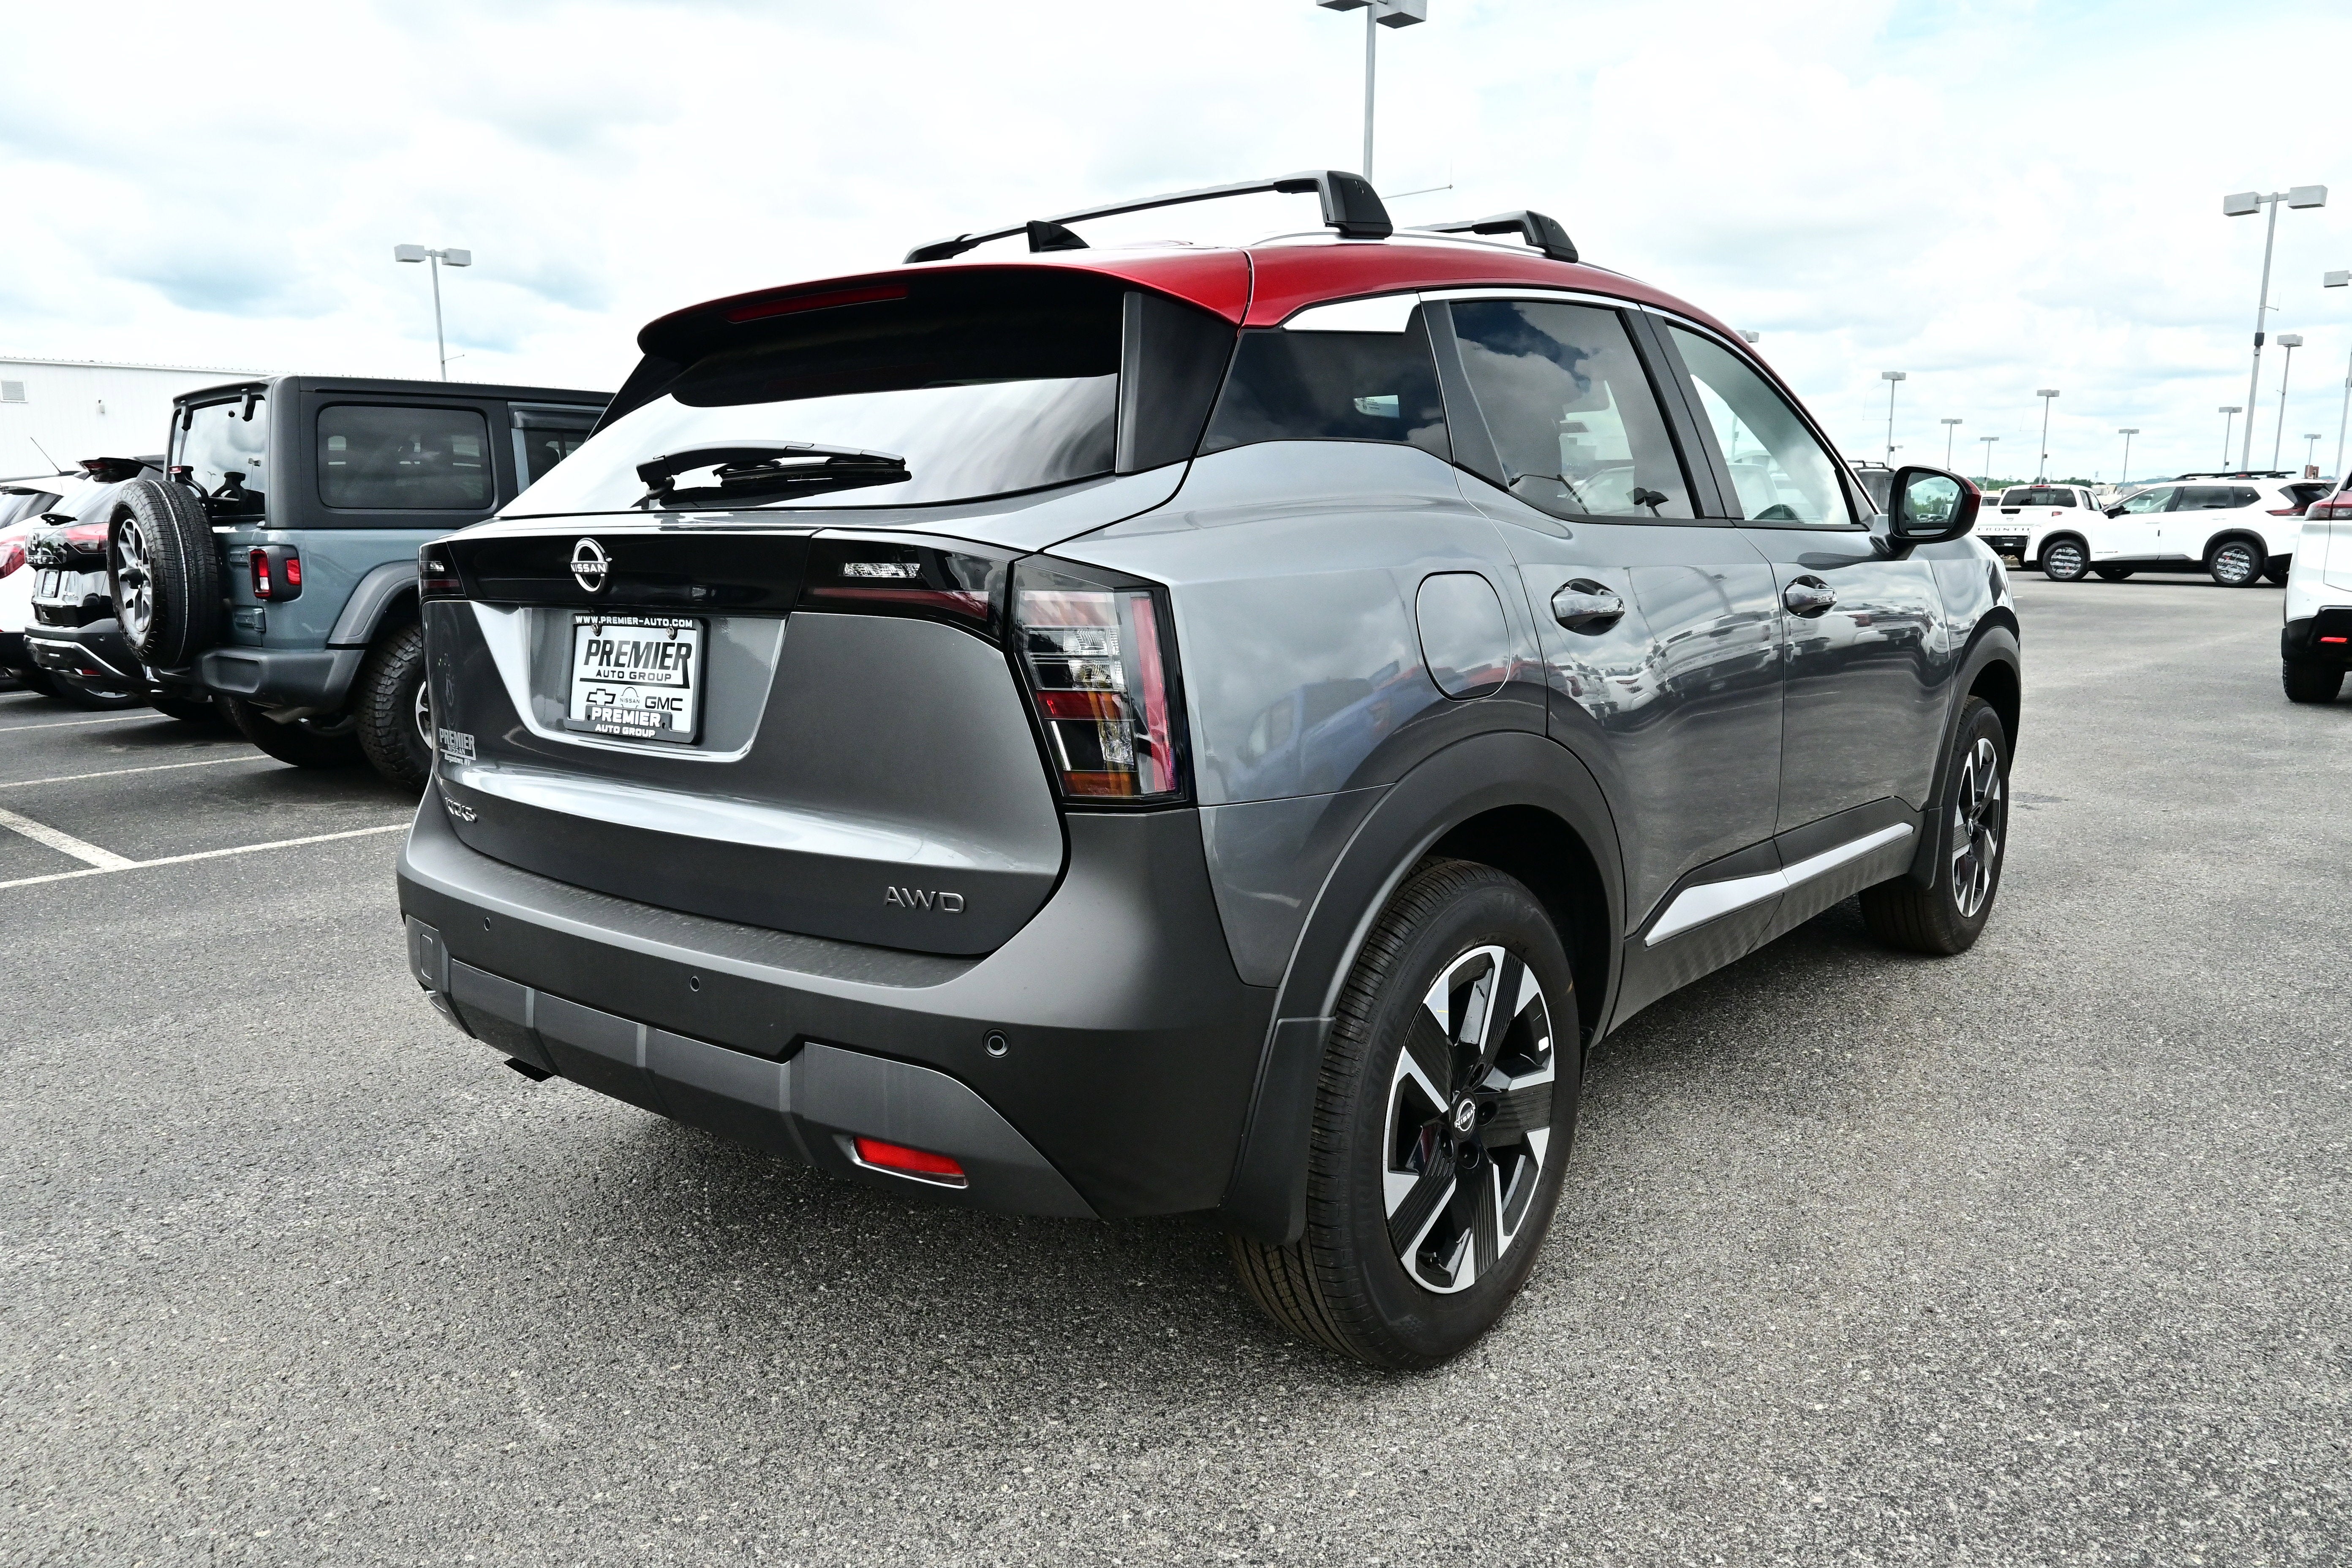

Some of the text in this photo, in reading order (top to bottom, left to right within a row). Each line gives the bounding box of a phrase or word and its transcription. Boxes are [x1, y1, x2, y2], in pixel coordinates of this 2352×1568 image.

[570, 564, 606, 572] NISSAN
[575, 615, 693, 628] WWW.PREMIER-AUTO.COM
[583, 639, 692, 672] PREMIER
[596, 669, 672, 682] AUTO GROUP
[645, 696, 683, 711] GMC
[591, 706, 661, 728] PREMIER
[439, 727, 475, 750] PREMIER
[595, 724, 656, 738] AUTO GROUP
[448, 744, 466, 755] NISSAN
[883, 886, 966, 914] AWD
[1454, 1103, 1475, 1128] NISSAN
